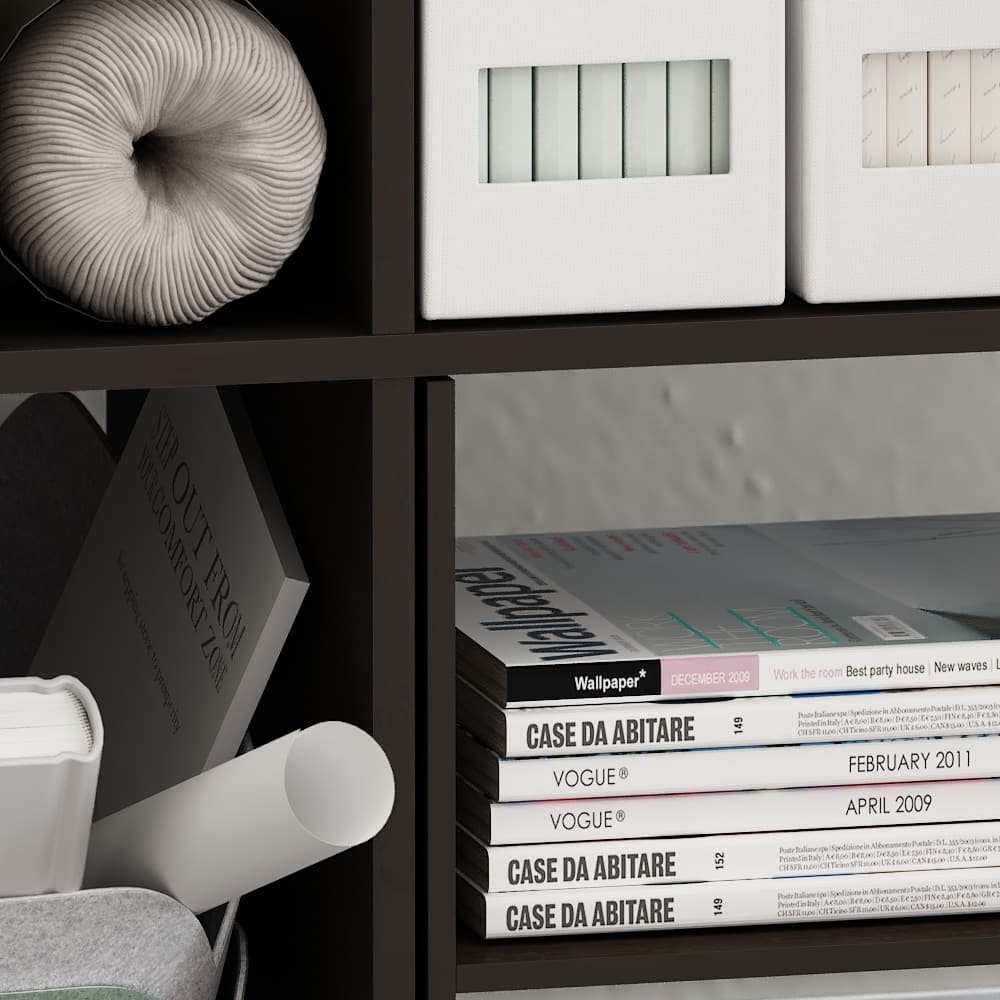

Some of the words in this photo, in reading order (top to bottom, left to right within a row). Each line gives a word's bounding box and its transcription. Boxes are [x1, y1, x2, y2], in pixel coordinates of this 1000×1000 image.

[172, 461, 213, 558] OUT
[204, 547, 246, 661] FROM
[151, 486, 208, 632] COMFORT
[201, 624, 228, 693] ZONE
[671, 671, 726, 686] DECEMBER
[728, 670, 750, 683] 2009
[773, 668, 798, 682] Work
[799, 667, 817, 680] the
[819, 668, 843, 679] room
[846, 665, 867, 677] Best
[869, 663, 894, 679] party
[897, 662, 925, 676] house
[934, 661, 955, 673] New
[957, 661, 987, 671] waves
[527, 721, 576, 750] CASE
[581, 719, 608, 747] DA
[612, 716, 695, 744] ABITARE
[734, 717, 743, 735] 149
[849, 752, 930, 773] FEBRUARY
[936, 750, 972, 769] 2011
[846, 797, 891, 816] APRIL
[895, 795, 932, 813] 2009
[508, 857, 558, 886] CASE
[563, 856, 590, 883] DA
[594, 852, 677, 880] ABITARE
[715, 852, 725, 870] 152
[506, 904, 556, 932] CASE
[562, 902, 588, 929] DA
[592, 898, 675, 926] ABITARE
[713, 898, 723, 917] 149
